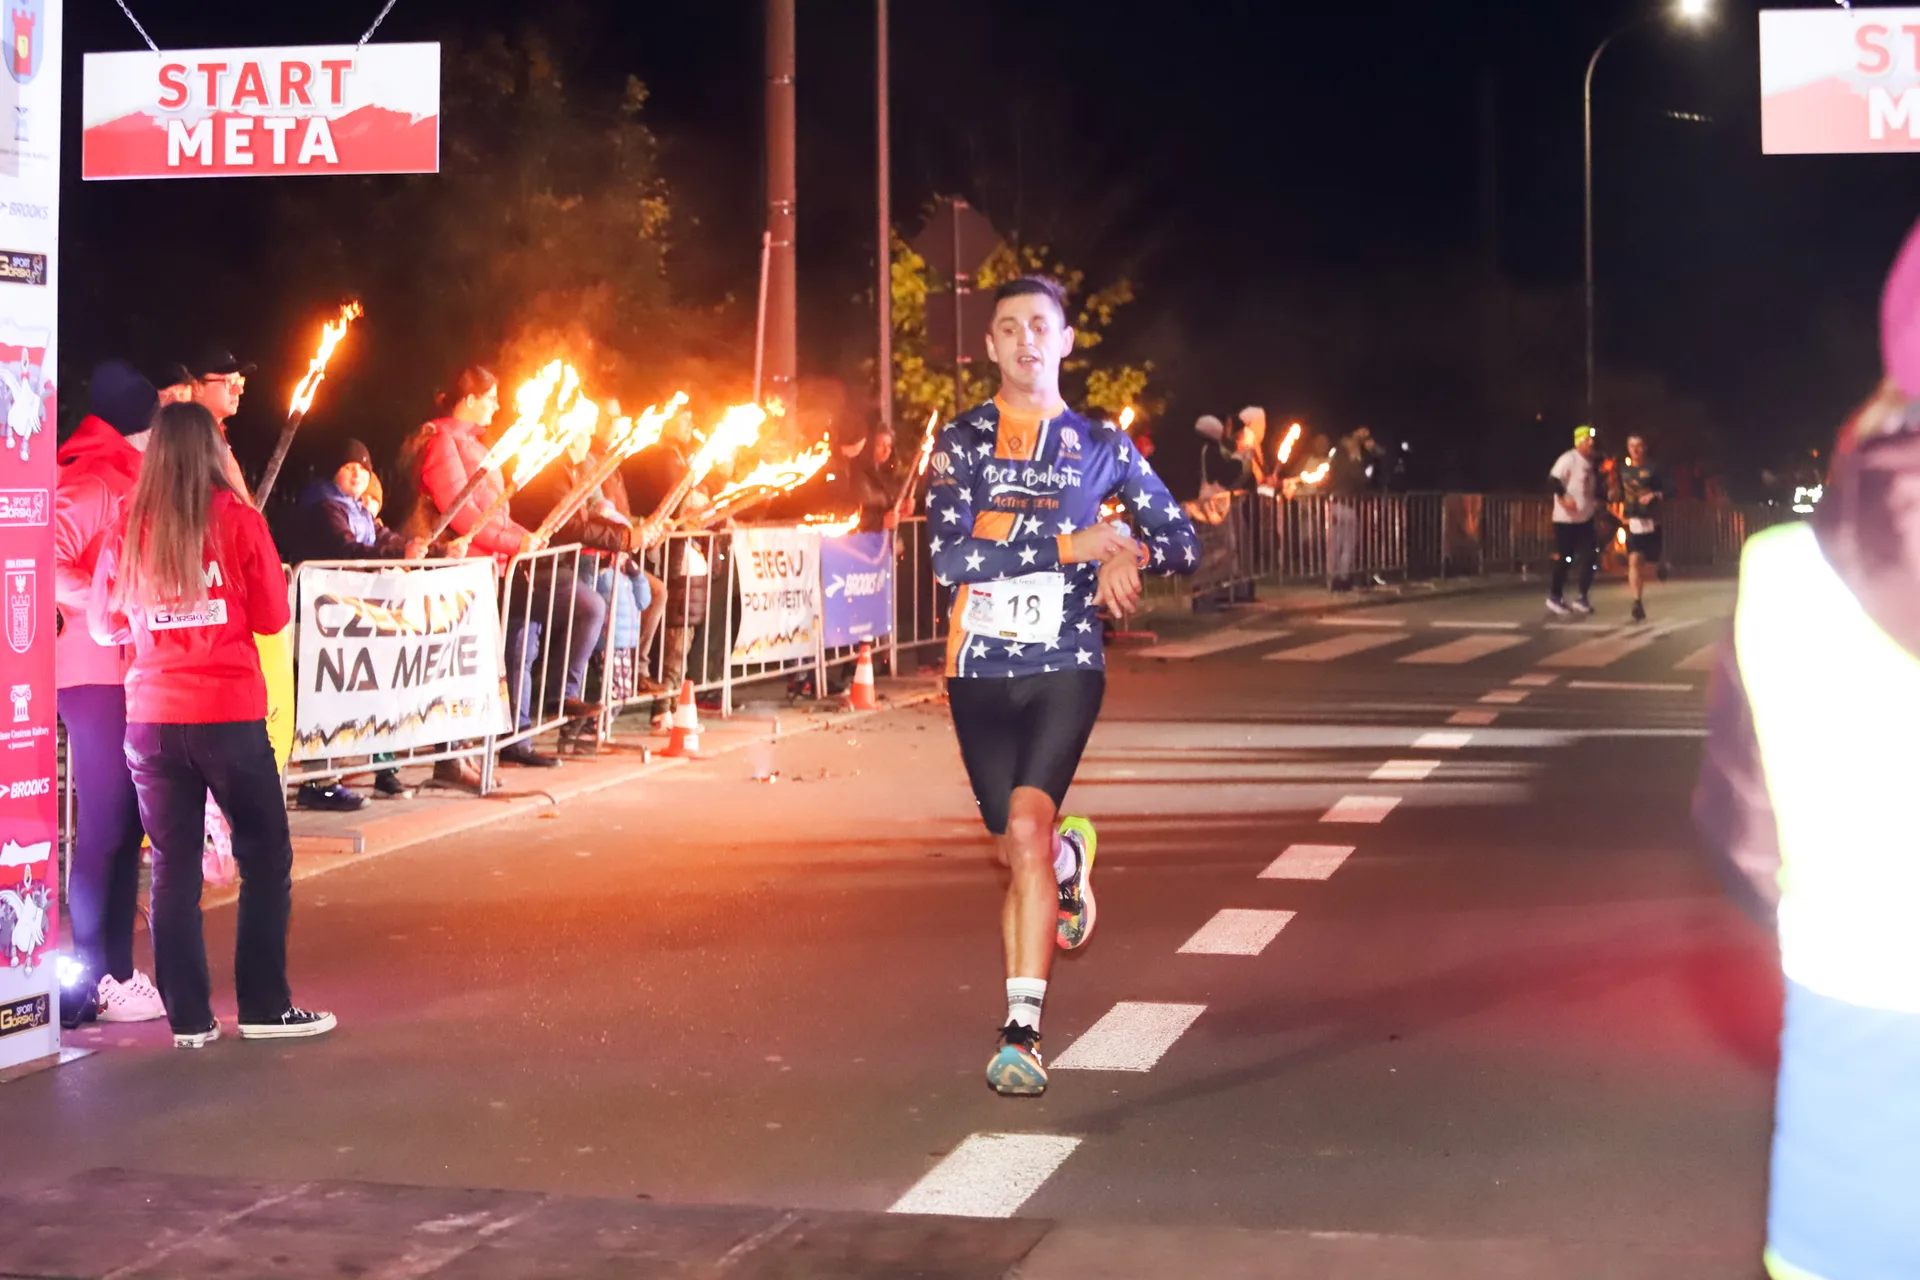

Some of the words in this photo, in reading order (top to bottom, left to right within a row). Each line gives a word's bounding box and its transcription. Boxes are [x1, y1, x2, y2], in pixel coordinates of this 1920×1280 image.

[158, 59, 353, 107] START
[167, 117, 339, 167] META
[9, 201, 49, 219] BROOKS
[1008, 595, 1041, 625] 18
[314, 646, 379, 693] NA
[10, 777, 51, 799] BROOKS
[16, 1004, 33, 1015] SPORT
